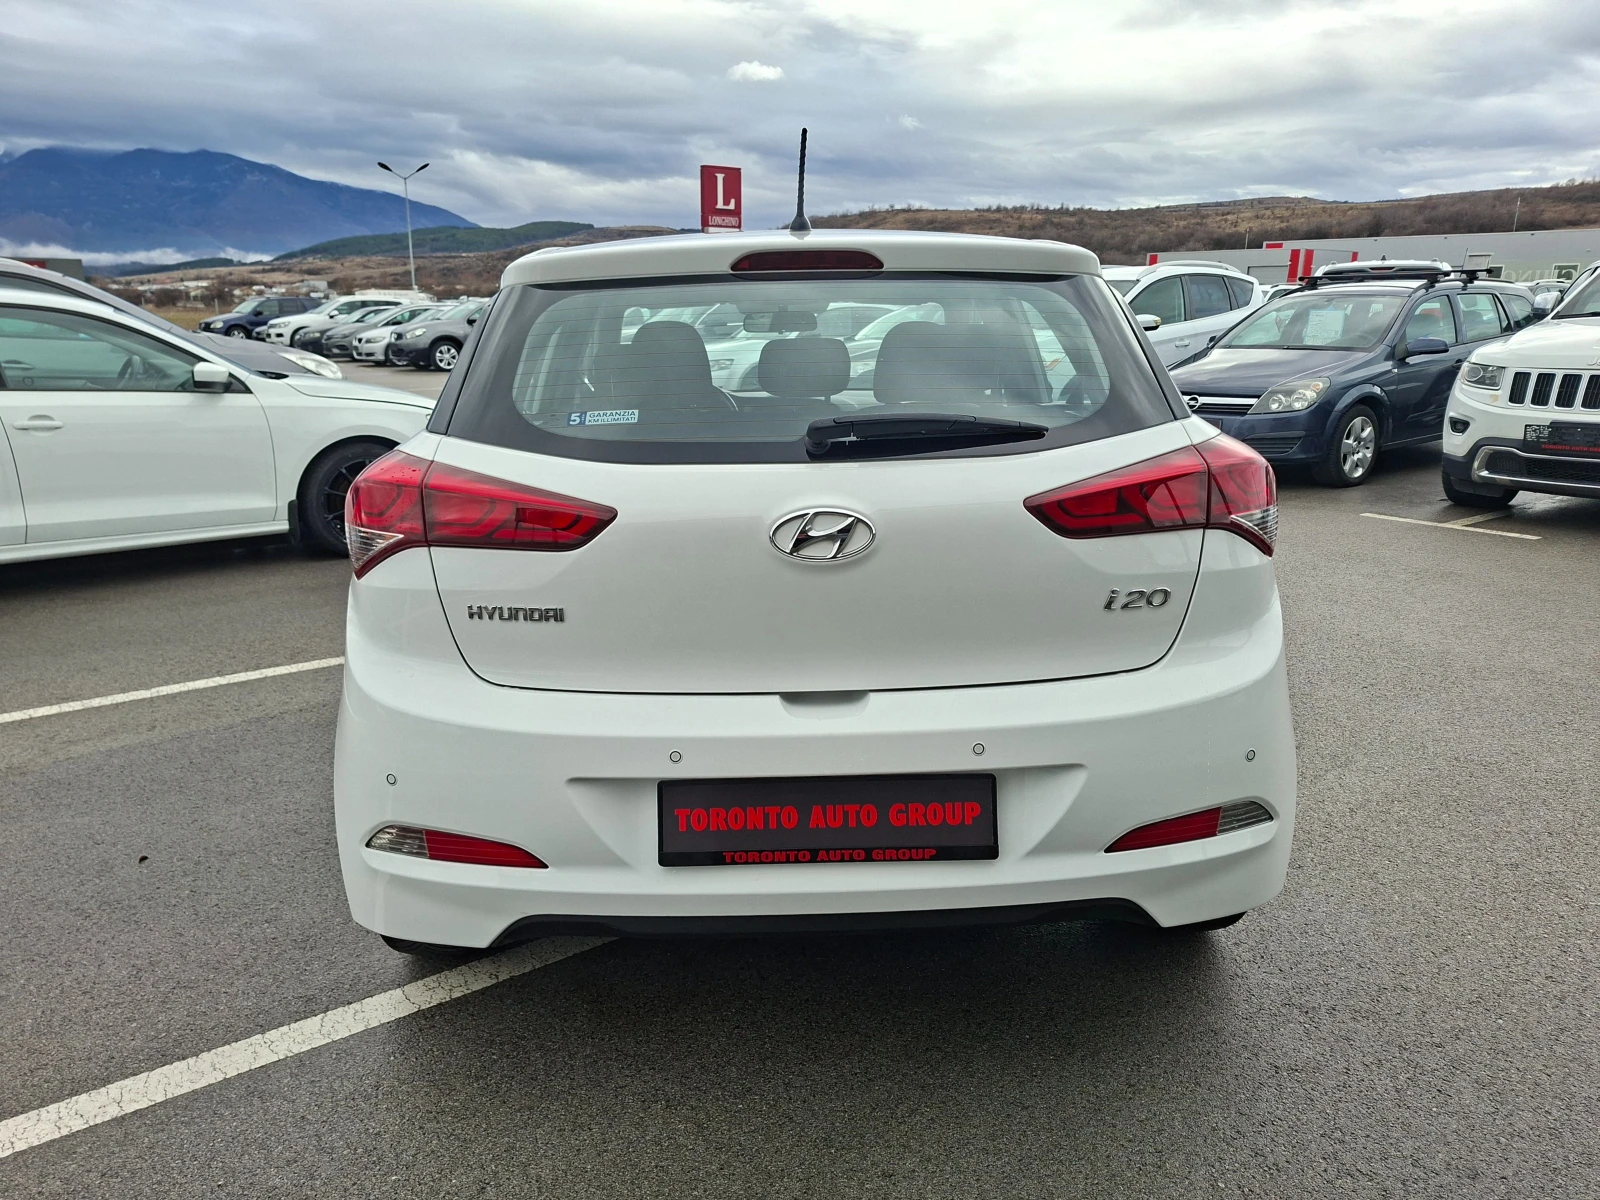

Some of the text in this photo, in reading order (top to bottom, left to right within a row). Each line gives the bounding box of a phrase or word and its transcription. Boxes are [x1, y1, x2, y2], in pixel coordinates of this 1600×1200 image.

[714, 173, 735, 210] L
[708, 215, 739, 227] LONGHINO
[569, 412, 581, 425] 5
[589, 410, 636, 418] GARANZIA
[467, 604, 565, 622] HYUNDAI
[674, 802, 982, 831] TORONTO AUTO GROUP
[723, 848, 938, 863] TORONTO AUTO GROUP
